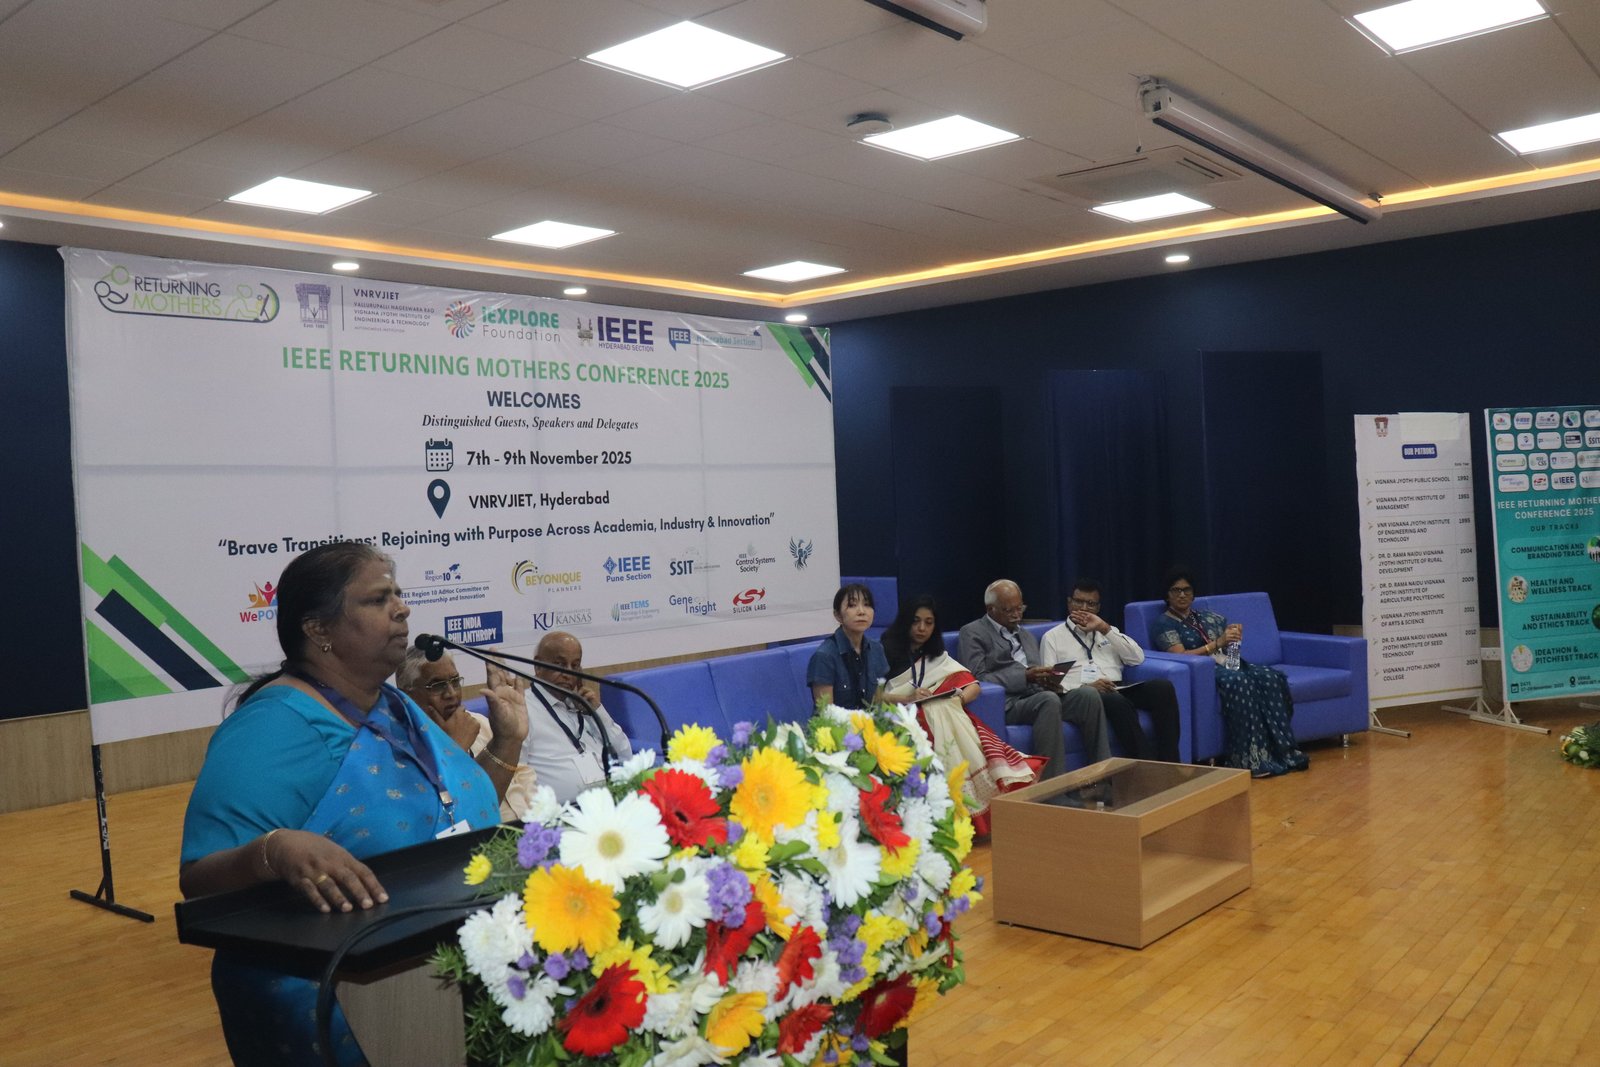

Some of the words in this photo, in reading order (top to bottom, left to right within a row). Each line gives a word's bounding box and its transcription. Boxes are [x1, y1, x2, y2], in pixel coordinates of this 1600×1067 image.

[134, 276, 221, 297] RETURNING
[353, 288, 400, 300] VNRVJIET
[132, 293, 223, 316] MOTHERS
[354, 309, 379, 317] VIGNANA
[396, 319, 430, 327] TECHNOLOGY
[482, 325, 561, 343] Foundation
[598, 316, 654, 345] IEEE
[670, 329, 690, 342] IEEE
[599, 342, 631, 351] HYDERABAD
[282, 346, 332, 370] IEEE
[339, 349, 470, 376] RETURNING
[476, 357, 571, 381] MOTHERS
[576, 363, 690, 388] CONFERENCE
[694, 370, 730, 389] 2025
[487, 390, 581, 409] WELCOMES
[422, 414, 492, 430] Distinguished
[494, 415, 530, 429] Guests,
[532, 415, 575, 431] Speakers
[577, 417, 594, 430] and
[596, 417, 639, 432] Delegates
[466, 449, 490, 466] 7th
[503, 449, 526, 466] 9th
[530, 449, 599, 465] November
[601, 450, 632, 465] 2025
[469, 493, 536, 509] VNRVJIET,
[540, 490, 610, 510] Hyderabad
[1497, 500, 1516, 510] IEEE
[1518, 498, 1566, 508] RETURNING
[1568, 496, 1600, 506] MOTHE
[1514, 509, 1572, 520] CONFERENCE
[1574, 507, 1595, 517] 2025
[382, 529, 451, 550] Rejoining
[454, 525, 485, 542] with
[488, 525, 543, 543] Purpose
[546, 522, 590, 537] Across
[593, 518, 657, 534] Academia,
[660, 516, 705, 532] Industry
[707, 516, 715, 528] &
[1530, 524, 1546, 532] OUR
[1510, 544, 1568, 554] COMMUNICATION
[1569, 543, 1585, 551] AND
[735, 557, 755, 567] Control
[755, 556, 776, 566] Systems
[1527, 551, 1563, 560] BRANDING
[618, 555, 651, 573] IEEE
[669, 560, 694, 576] SSIT
[740, 565, 759, 573] Society
[425, 574, 442, 582] Region
[442, 572, 451, 581] 10
[1379, 567, 1413, 575] DEVELOPMENT
[525, 571, 582, 587] BEYONIQUE
[606, 574, 624, 583] Pune
[626, 572, 652, 582] Section
[1530, 578, 1559, 587] HEALTH
[1559, 577, 1574, 585] AND
[412, 590, 430, 598] Region
[455, 586, 482, 594] Committee
[547, 585, 582, 593] PLANNERS
[1531, 586, 1567, 595] WELLNESS
[1568, 584, 1593, 592] TRACK
[404, 597, 448, 606] Entrepreneurship
[459, 593, 486, 601] Innovation
[669, 594, 693, 606] Gene
[1380, 596, 1412, 604] AGRICULTURE
[1413, 593, 1445, 601] POLYTECHNIC
[685, 600, 717, 616] Insight
[732, 606, 752, 614] SILICON
[754, 604, 767, 612] LABS
[240, 608, 279, 623] WePO
[533, 612, 555, 631] KU
[556, 612, 592, 625] KANSAS
[1530, 610, 1588, 622] SUSTAINABILITY
[447, 618, 462, 632] IEEE
[463, 616, 482, 629] INDIA
[1539, 620, 1565, 629] ETHICS
[1565, 618, 1590, 627] TRACK
[447, 627, 497, 645] PHILANTHROPY
[1382, 650, 1414, 659] TECHNOLOGY
[1535, 647, 1572, 656] IDEATHON
[1535, 654, 1573, 664] PITCHFEST
[1574, 652, 1599, 660] TRACK
